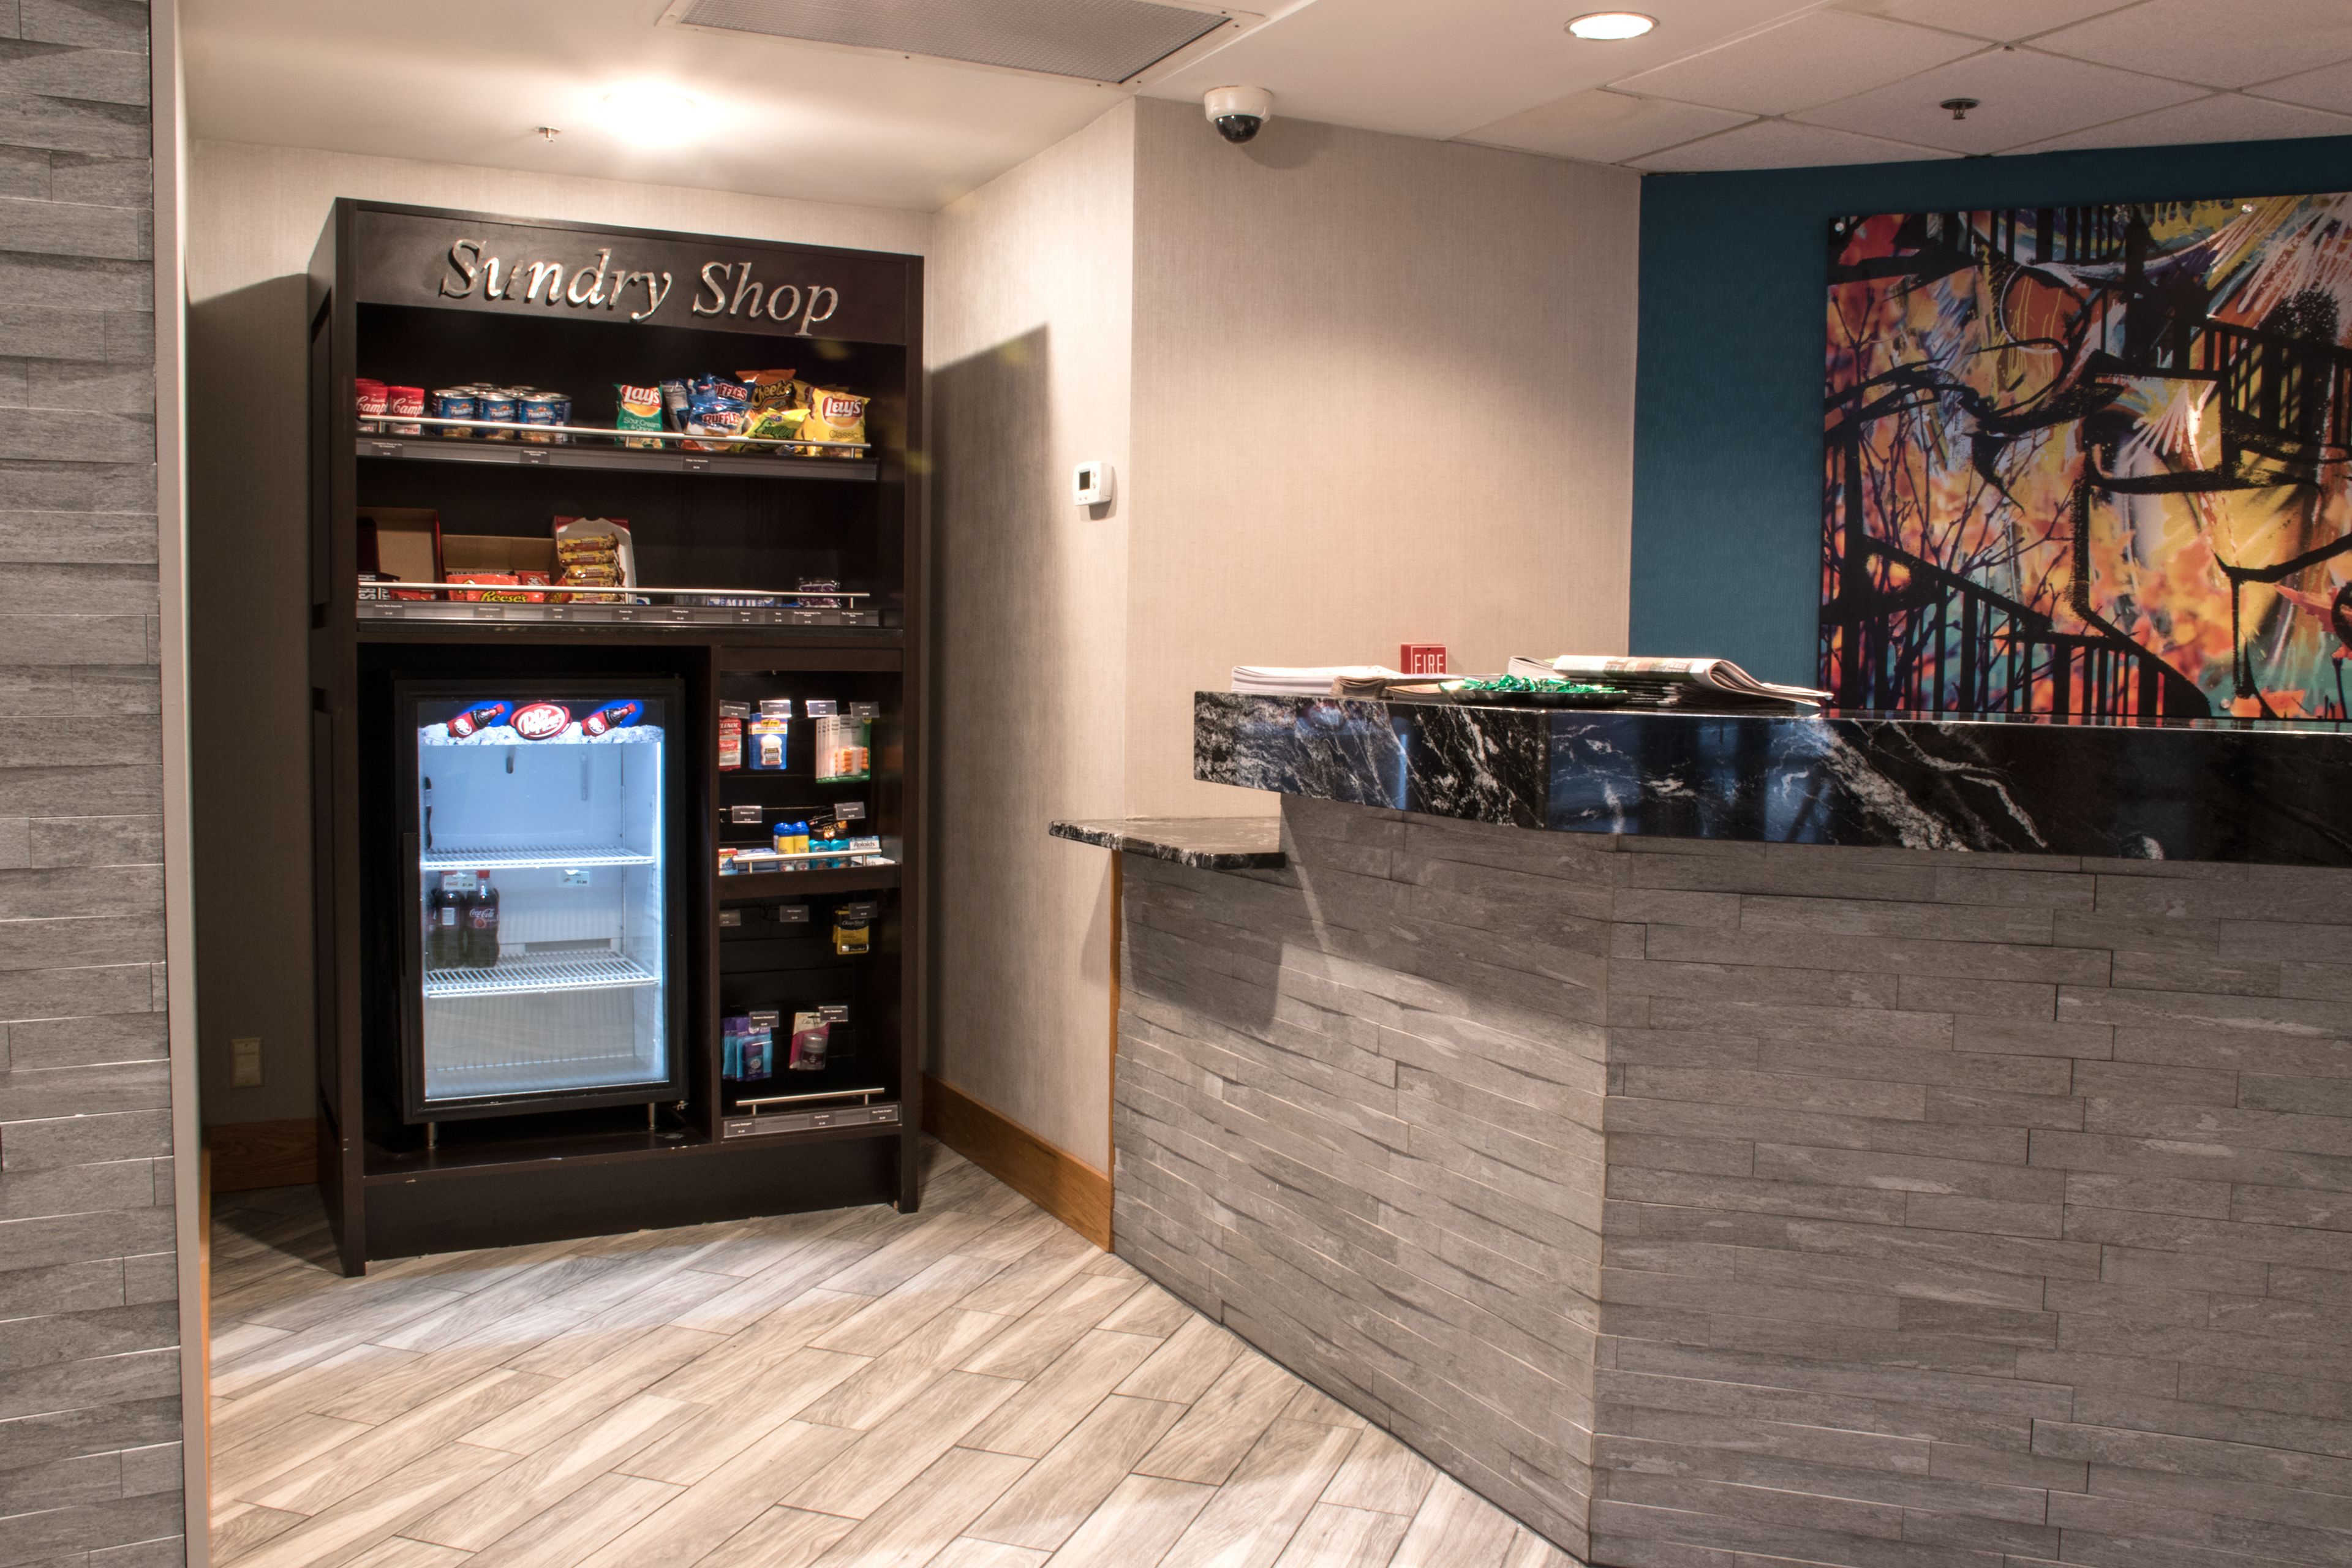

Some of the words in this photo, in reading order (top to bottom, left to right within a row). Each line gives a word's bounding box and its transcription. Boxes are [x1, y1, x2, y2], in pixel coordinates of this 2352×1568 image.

[440, 239, 672, 322] Sundry
[692, 261, 839, 336] Shop
[621, 385, 660, 405] Lay's
[715, 383, 747, 401] UFFLES
[751, 380, 793, 409] Cheetos
[824, 397, 862, 417] Lay's
[829, 430, 858, 439] Classic
[481, 590, 527, 603] Reese's
[1414, 654, 1444, 674] FIRE
